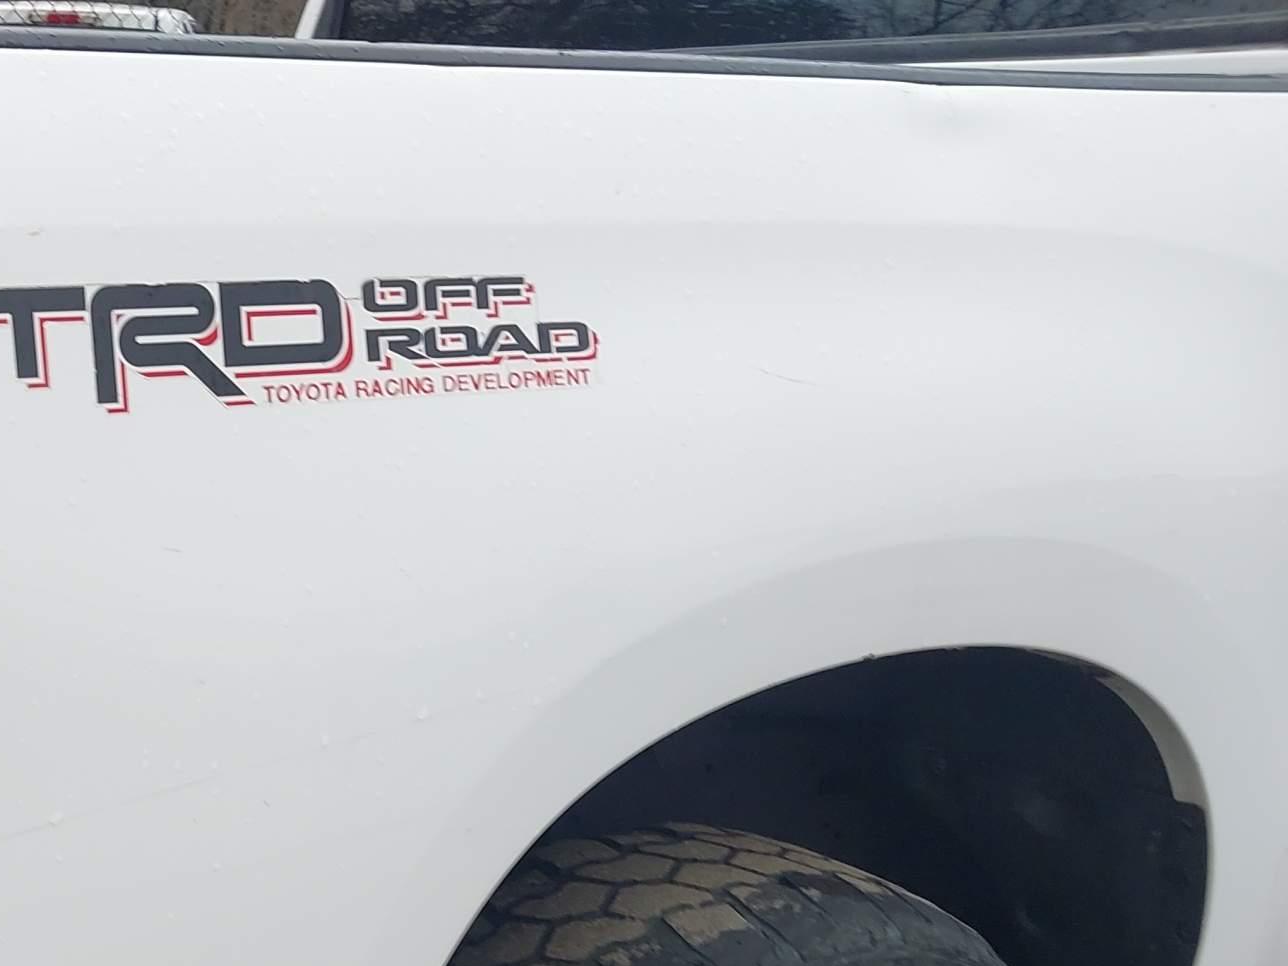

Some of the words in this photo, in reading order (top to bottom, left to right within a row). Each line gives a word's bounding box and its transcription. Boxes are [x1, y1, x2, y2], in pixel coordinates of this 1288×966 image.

[361, 276, 535, 319] OFF
[364, 322, 598, 369] ROAD
[263, 381, 348, 405] TOYOTA
[355, 374, 435, 399] RACING
[441, 367, 591, 395] DEVELOPMENT
